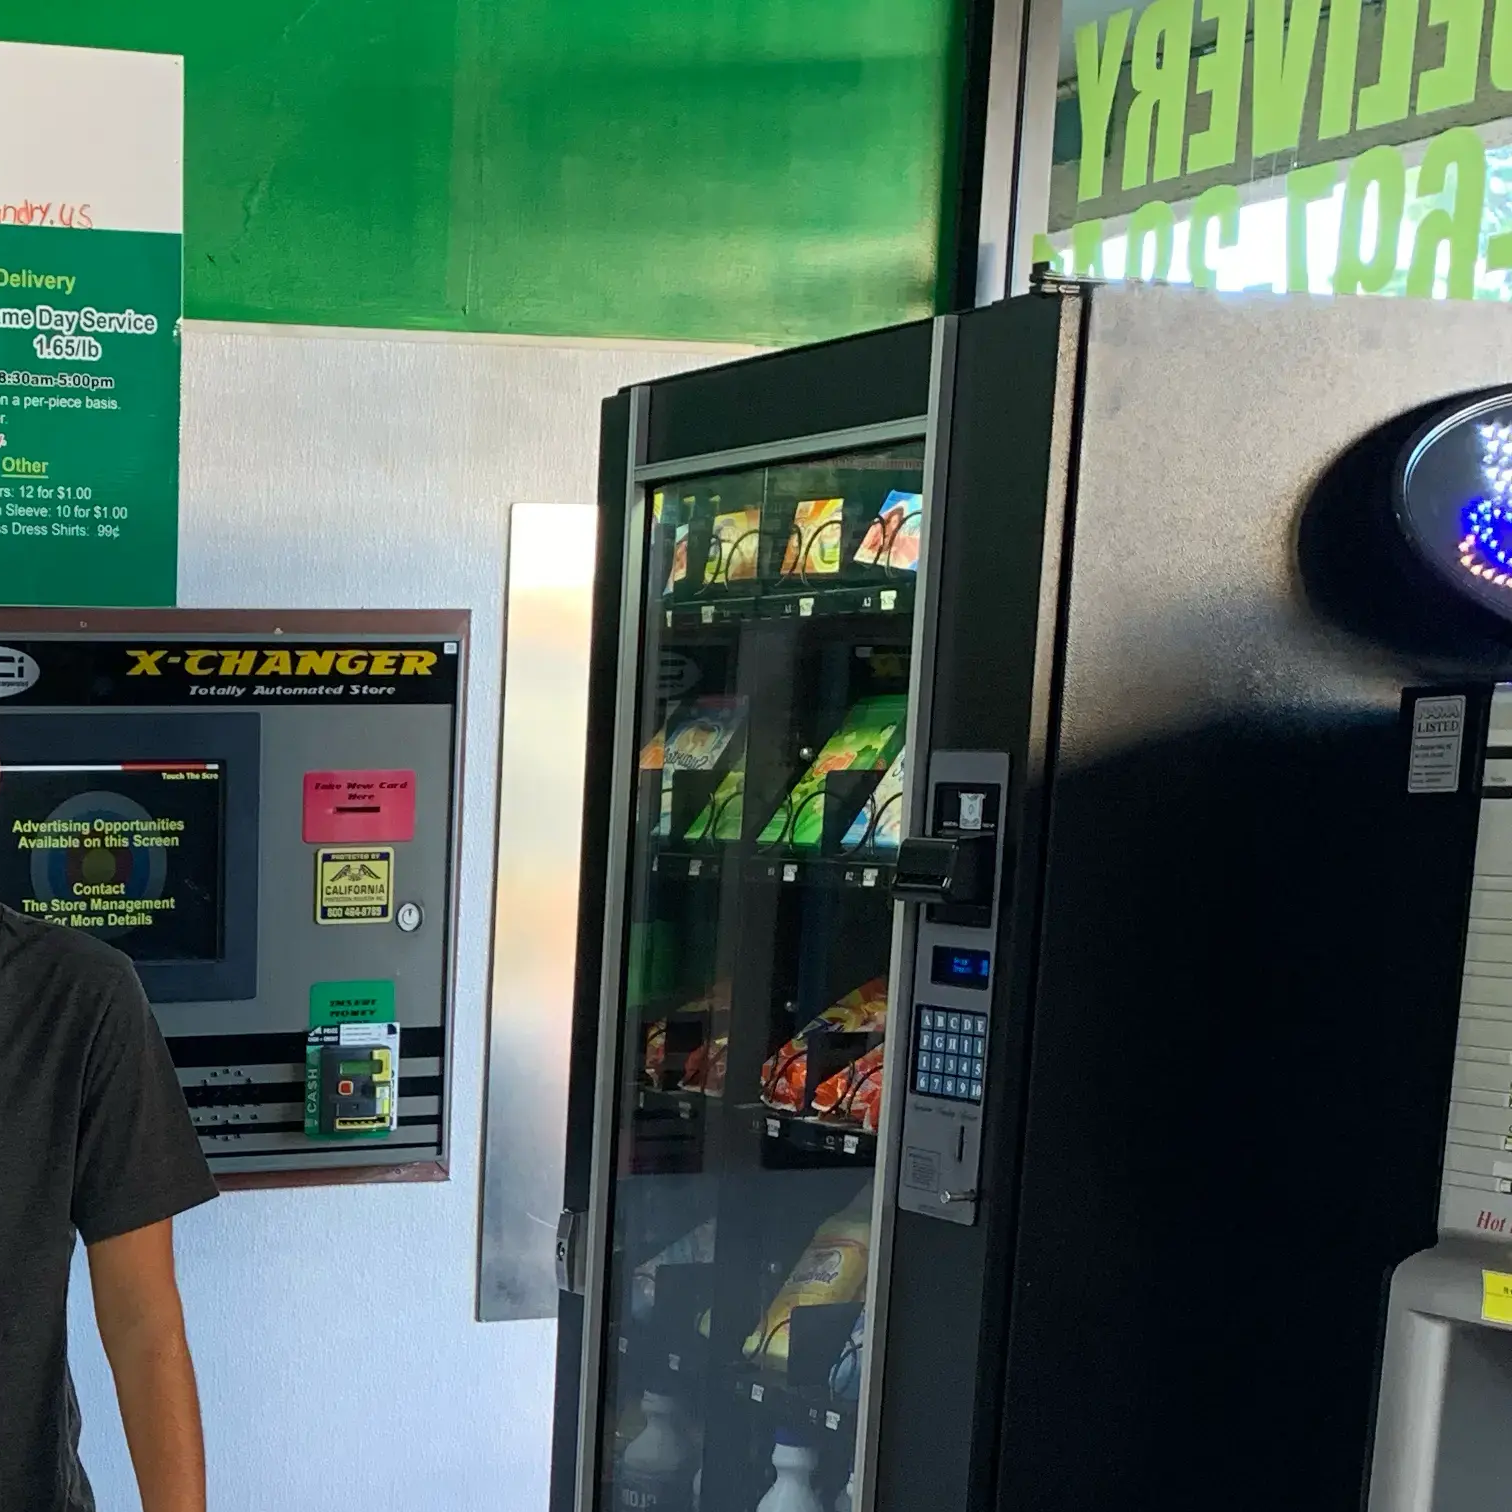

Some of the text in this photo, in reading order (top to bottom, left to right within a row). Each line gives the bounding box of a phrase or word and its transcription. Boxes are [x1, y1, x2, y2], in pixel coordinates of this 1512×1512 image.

[39, 307, 79, 334] Day
[82, 309, 156, 332] Service
[35, 336, 100, 359] 1.65/lb
[12, 396, 20, 406] a
[24, 394, 82, 411] per-piece
[86, 395, 121, 410] basis.
[2, 456, 49, 474] Other
[126, 650, 438, 675] X-CHANGER
[190, 684, 395, 697] Totally Automated Store
[1417, 721, 1459, 733] LISTED
[325, 884, 385, 896] CALIFORNIA
[307, 1068, 318, 1113] CASH
[1477, 1210, 1506, 1232] Hot
